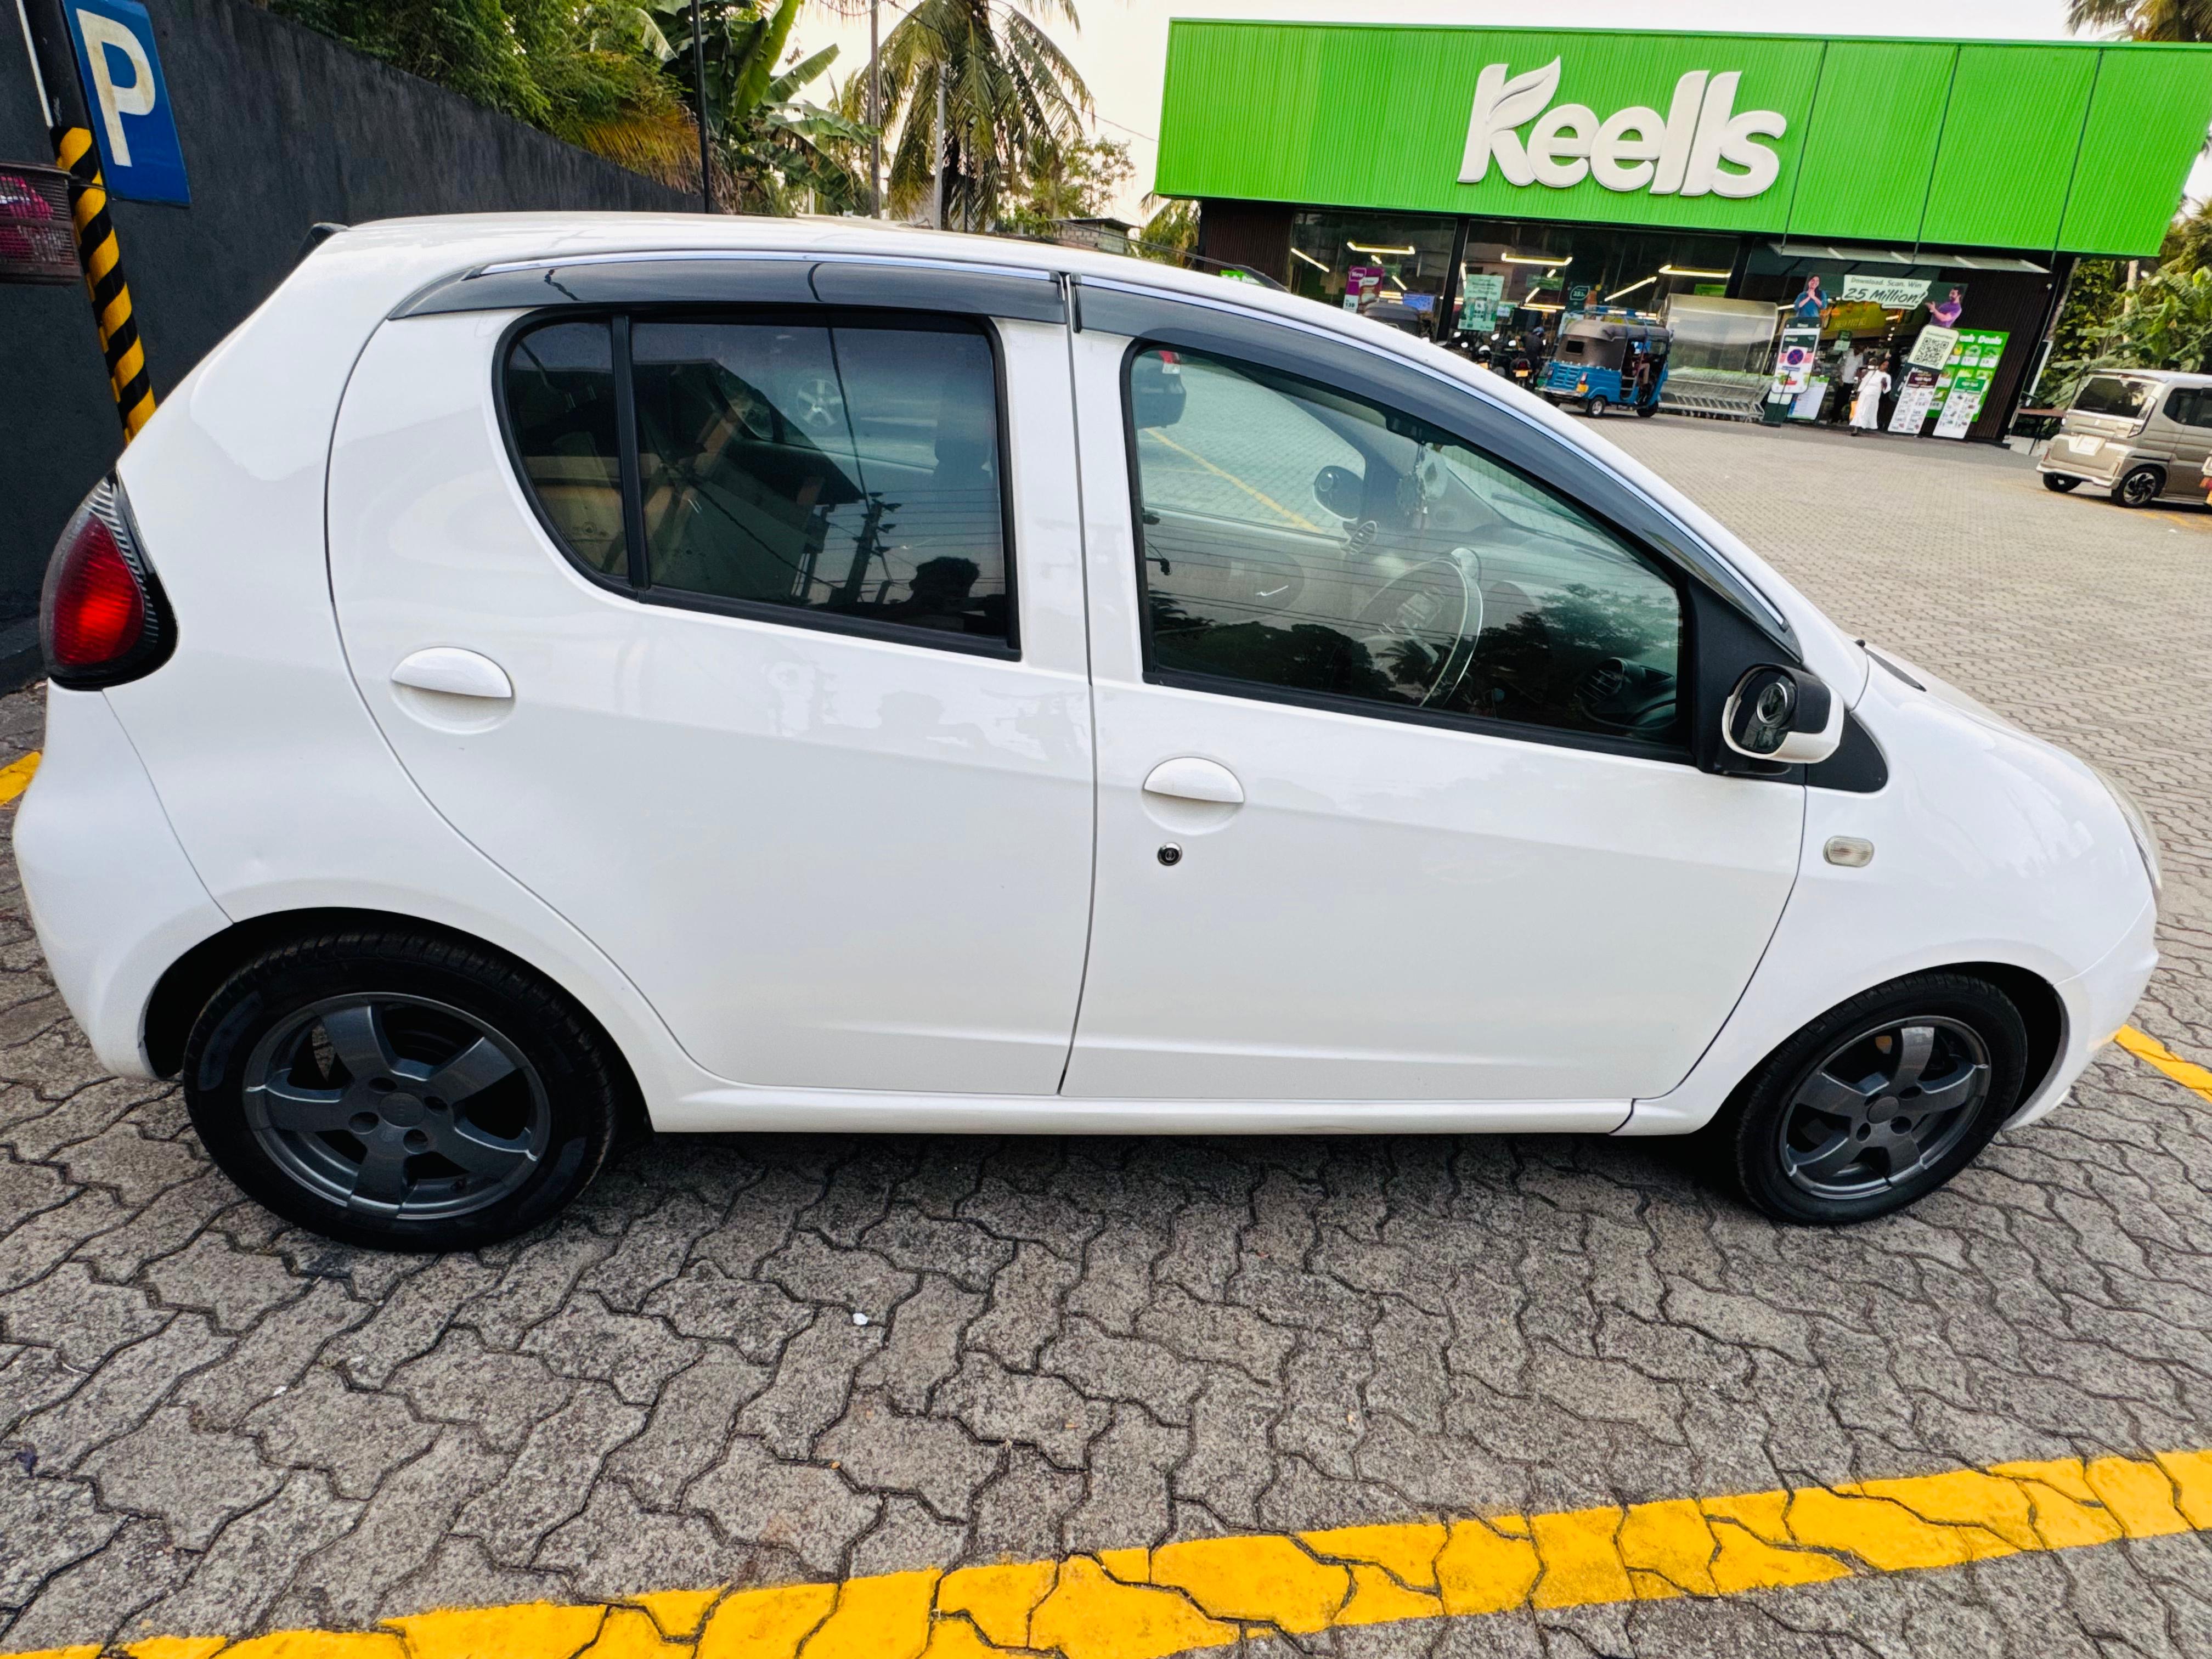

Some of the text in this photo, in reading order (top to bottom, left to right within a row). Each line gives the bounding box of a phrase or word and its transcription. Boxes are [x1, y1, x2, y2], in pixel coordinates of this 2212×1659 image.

[76, 8, 156, 167] P
[1457, 55, 1787, 199] Keells
[1844, 288, 1926, 303] 25 Million!
